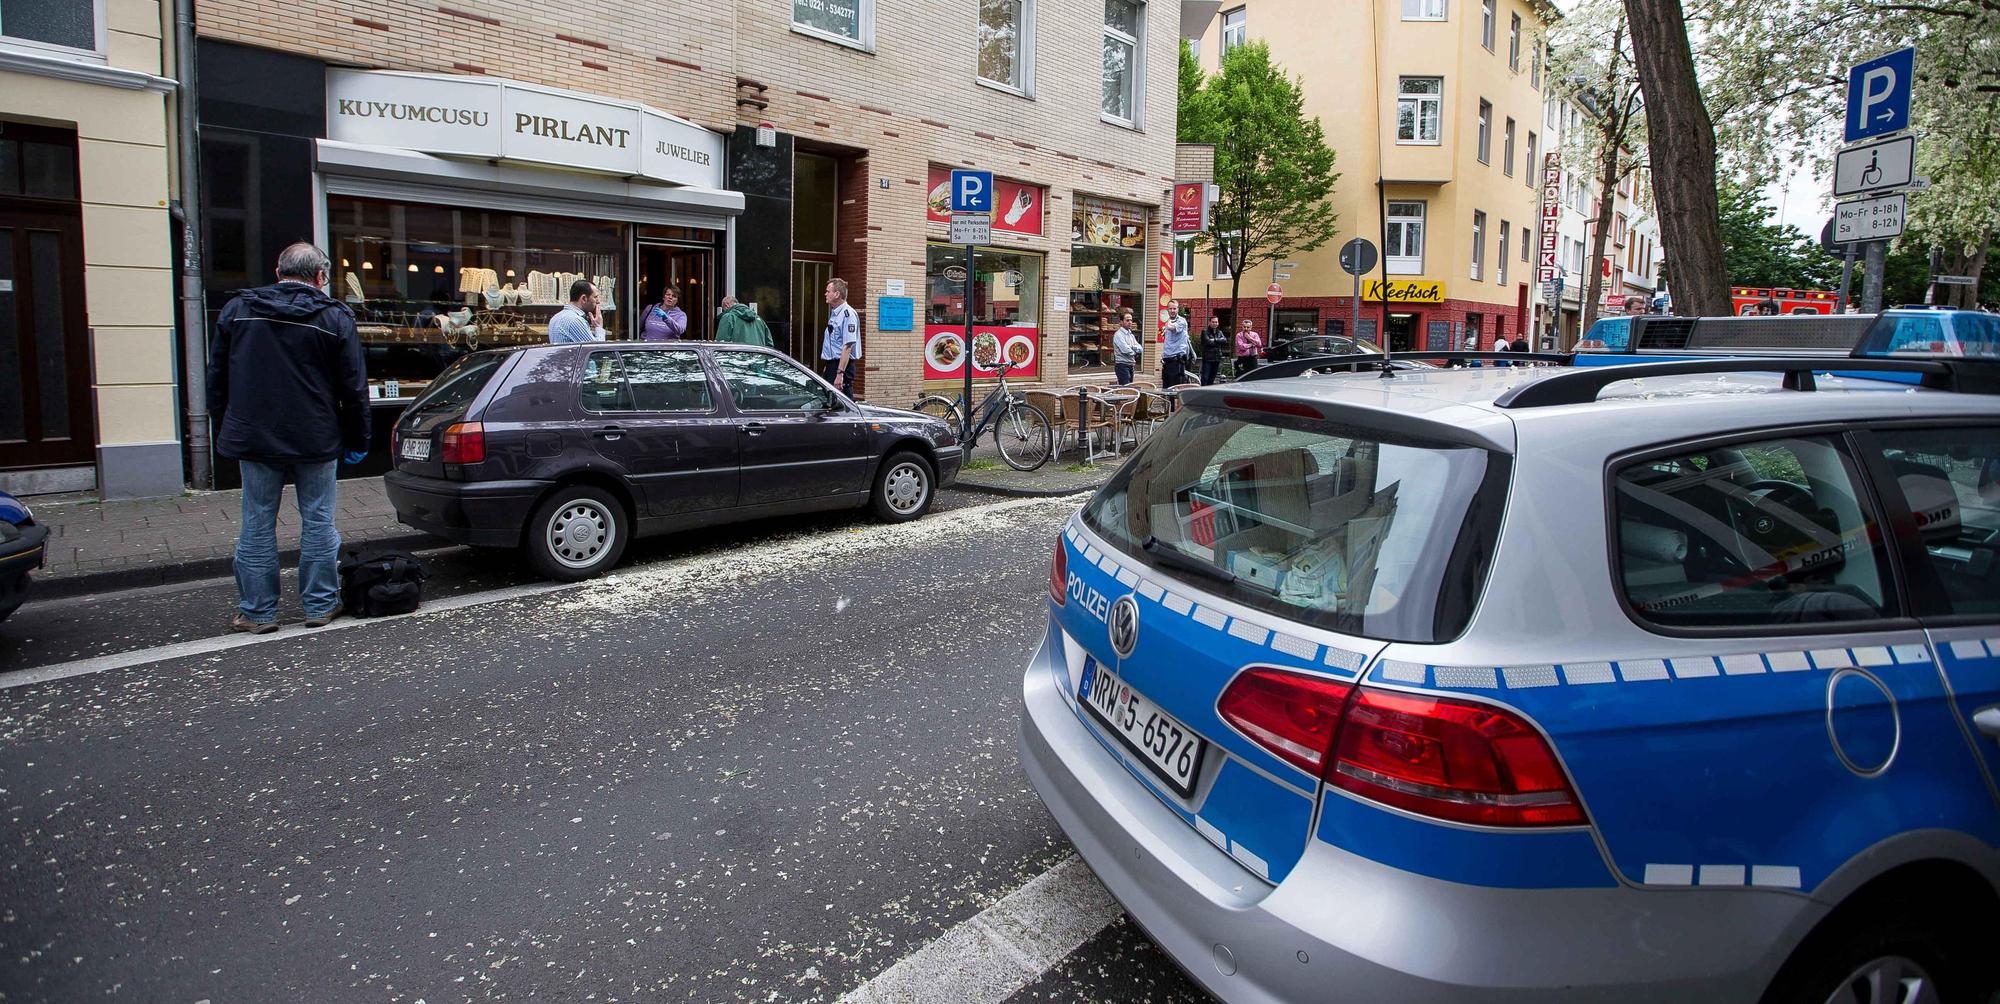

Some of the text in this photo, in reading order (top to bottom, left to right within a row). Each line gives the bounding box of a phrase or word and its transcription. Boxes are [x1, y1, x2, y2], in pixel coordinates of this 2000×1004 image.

[829, 4, 855, 19] 5342777
[1859, 66, 1896, 129] P
[337, 99, 489, 128] KUYUMCUSU
[515, 112, 631, 149] PIRLANT
[655, 140, 711, 166] JUWELIER
[961, 176, 982, 206] P
[1840, 208, 1868, 220] Mo-Fr
[1840, 224, 1850, 233] Sa
[1066, 571, 1111, 625] POLIZEI
[1089, 665, 1120, 717] NRW
[1124, 696, 1191, 778] 5-6576
